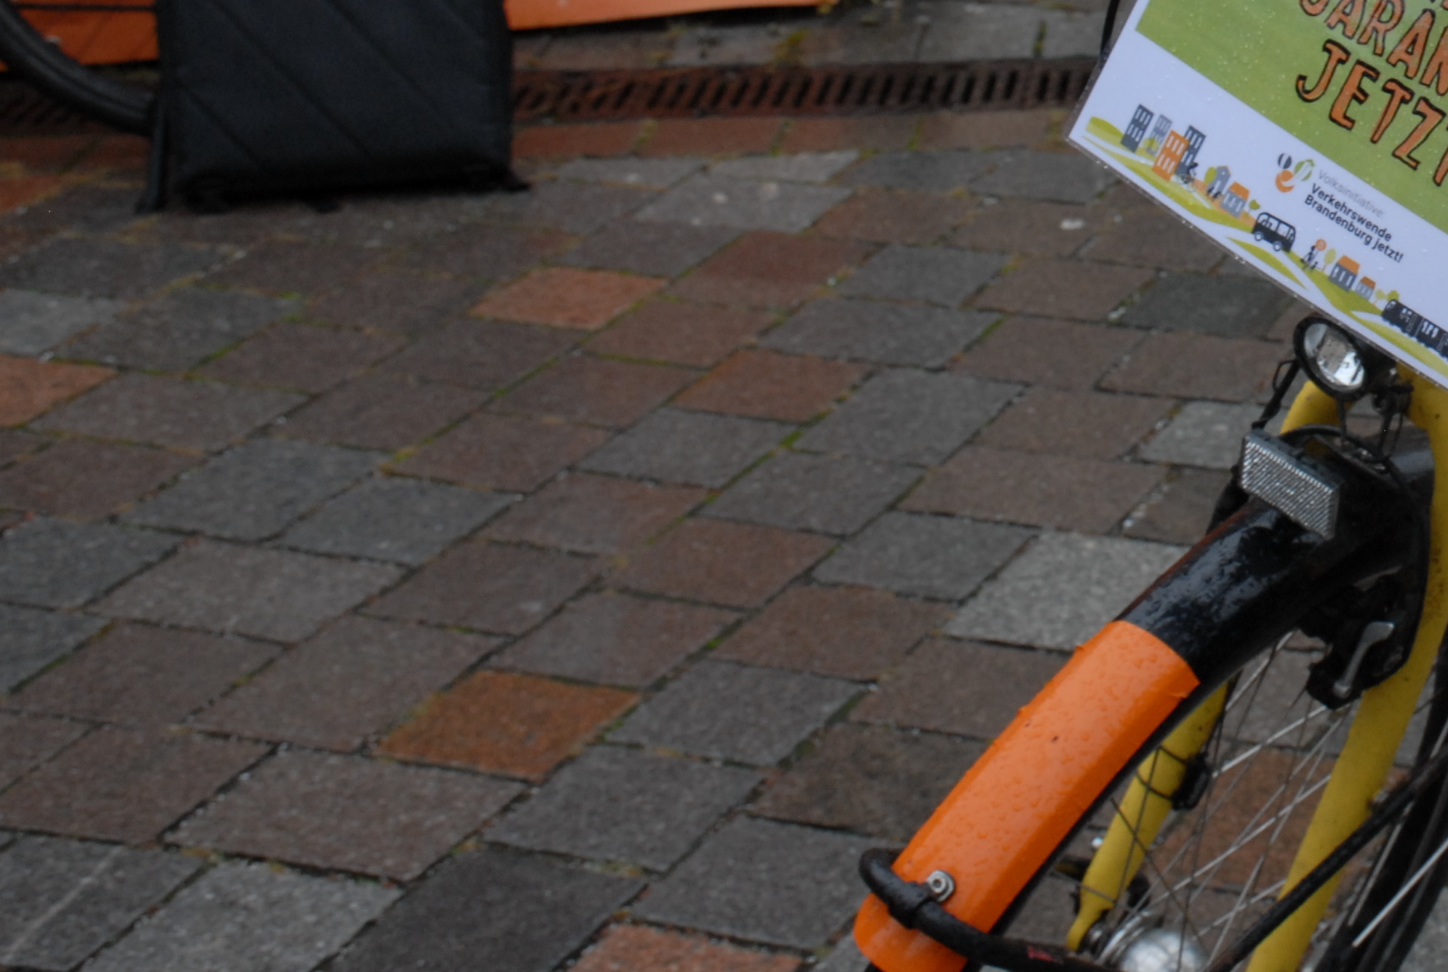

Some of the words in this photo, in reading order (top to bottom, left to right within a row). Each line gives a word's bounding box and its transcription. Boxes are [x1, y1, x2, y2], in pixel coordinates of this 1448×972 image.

[1303, 193, 1374, 246] Brandenburg
[1370, 237, 1405, 264] jetzt!
[1310, 182, 1393, 242] Verkehrswende
